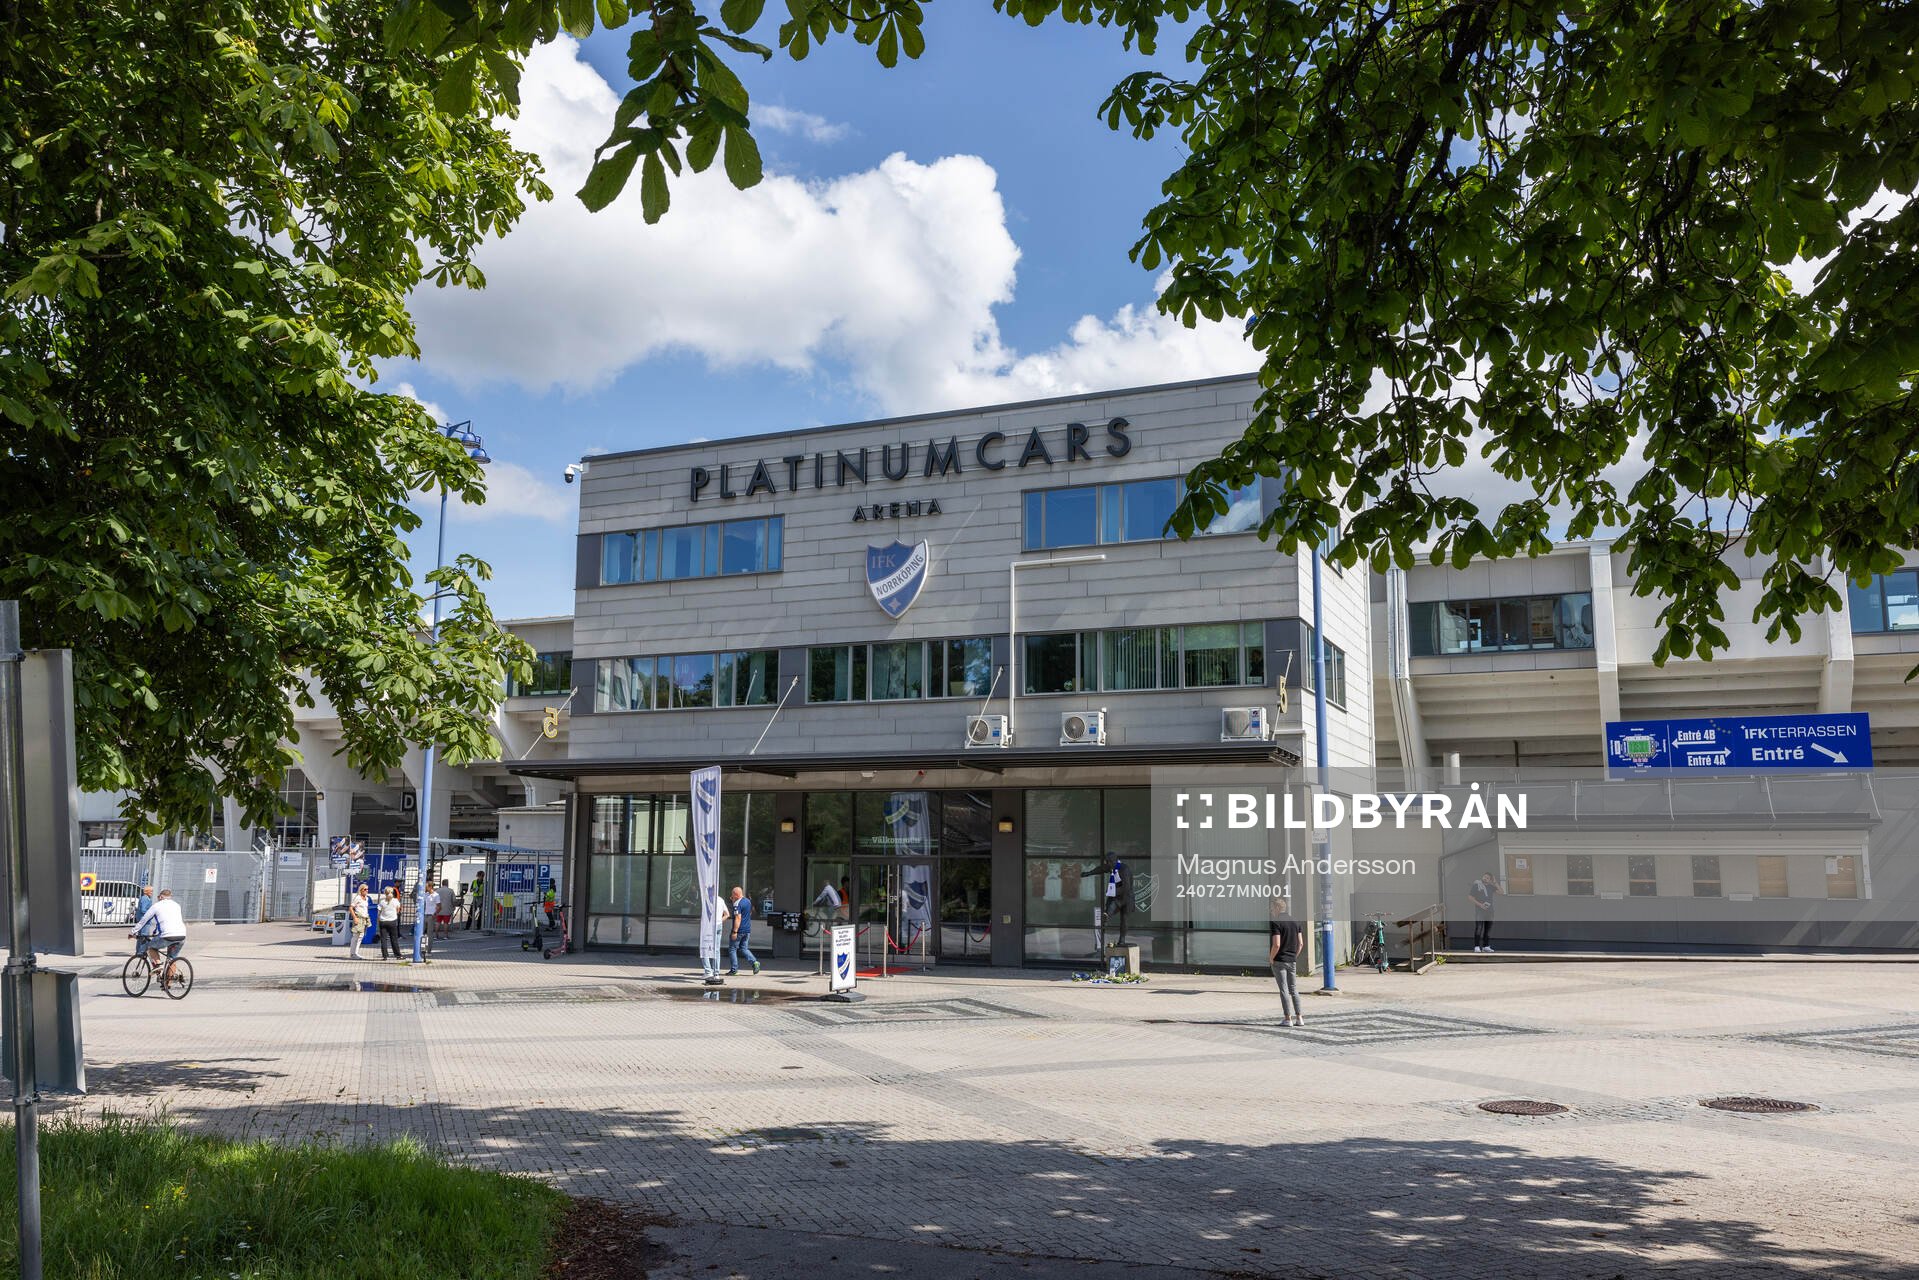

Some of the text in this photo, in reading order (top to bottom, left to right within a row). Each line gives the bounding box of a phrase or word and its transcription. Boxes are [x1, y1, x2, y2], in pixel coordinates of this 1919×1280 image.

[690, 417, 1131, 502] PLATINUMCARS
[852, 498, 942, 521] ARENA
[872, 554, 896, 569] IFK
[875, 554, 924, 596] NORRKÖPING
[1677, 729, 1716, 742] Entré 4B
[1687, 755, 1726, 767] Entré 4A
[1751, 746, 1804, 761] Entré
[404, 794, 415, 809] D
